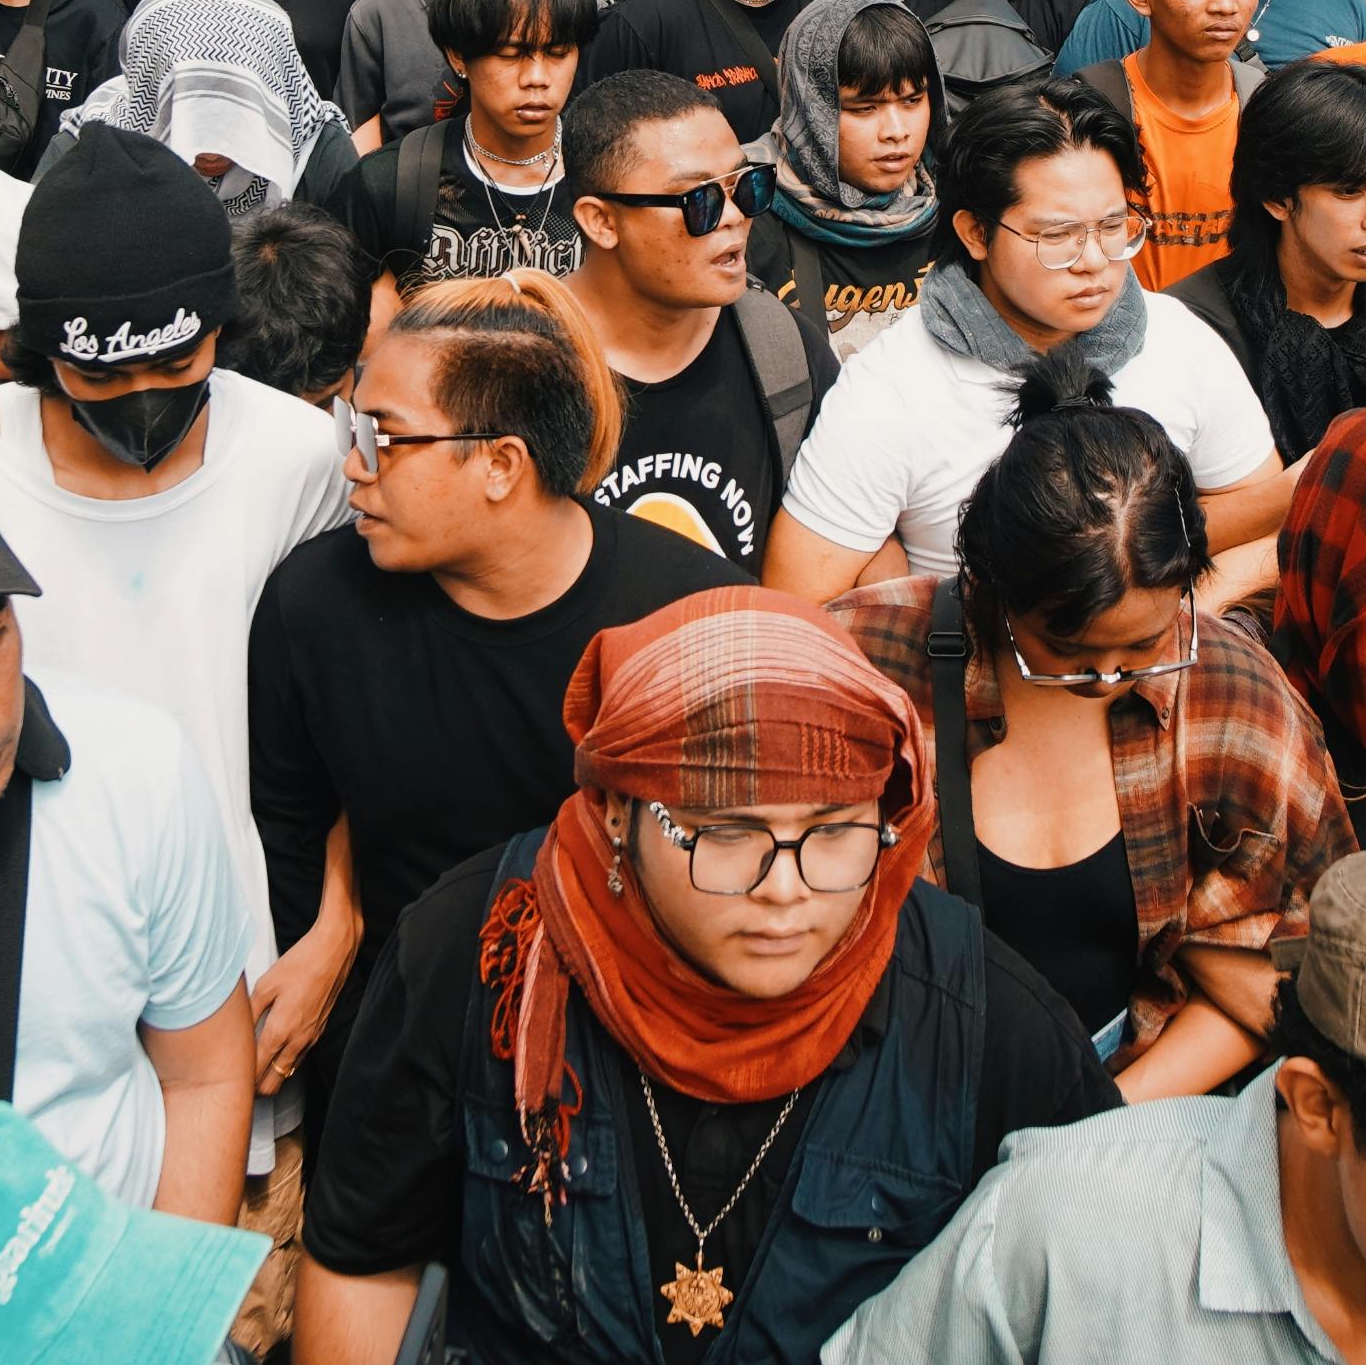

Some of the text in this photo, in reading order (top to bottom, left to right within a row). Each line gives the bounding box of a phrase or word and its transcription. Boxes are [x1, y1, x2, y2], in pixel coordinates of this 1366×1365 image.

[59, 307, 202, 363] Los Angeles
[594, 452, 755, 556] STAFFING NOW
